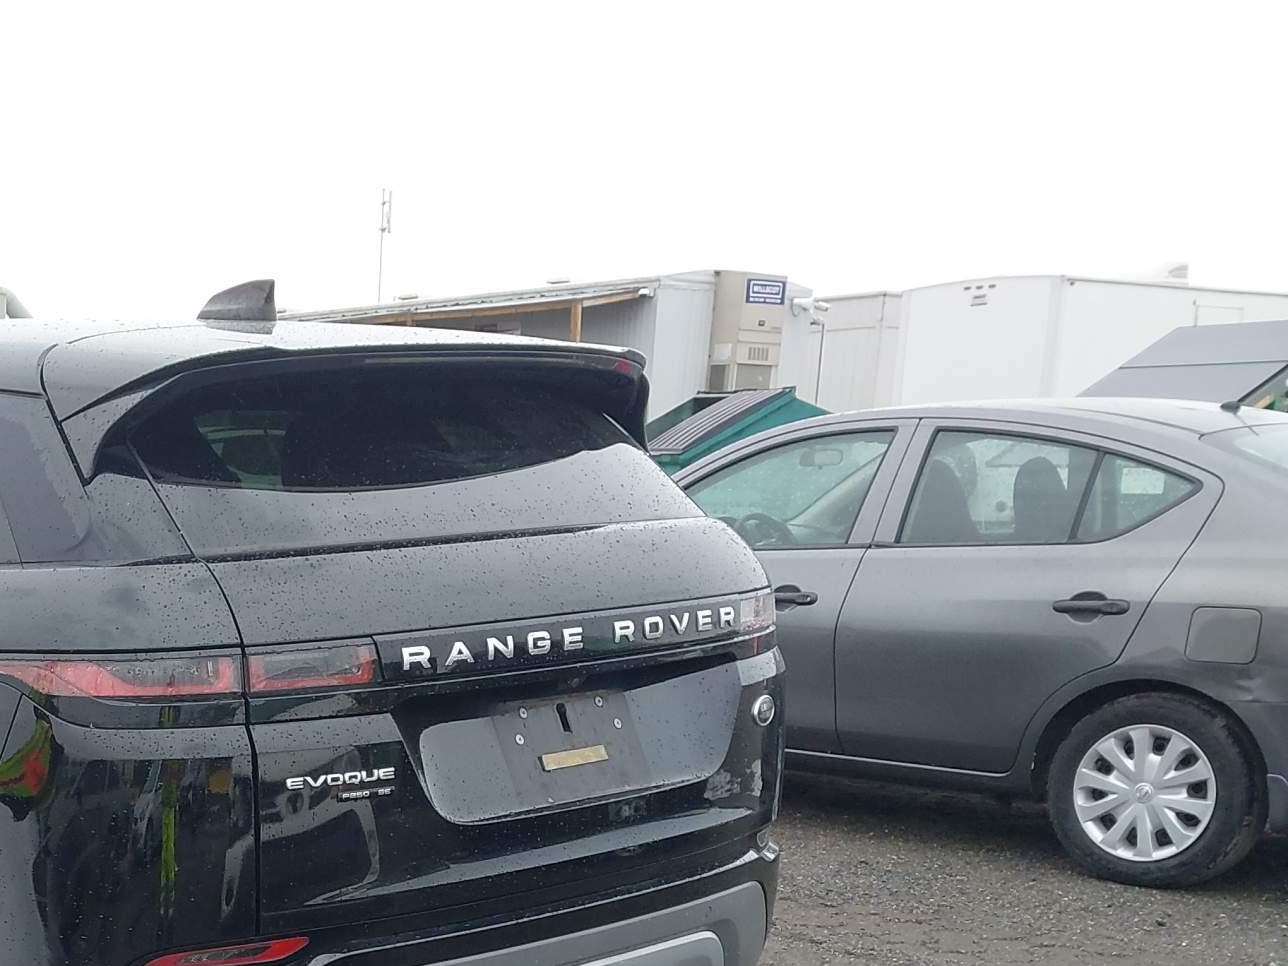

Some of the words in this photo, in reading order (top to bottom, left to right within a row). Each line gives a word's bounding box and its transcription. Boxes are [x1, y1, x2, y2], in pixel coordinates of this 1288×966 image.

[401, 626, 585, 671] RANGE
[613, 606, 736, 644] ROVER
[285, 767, 395, 790] EVOQUE
